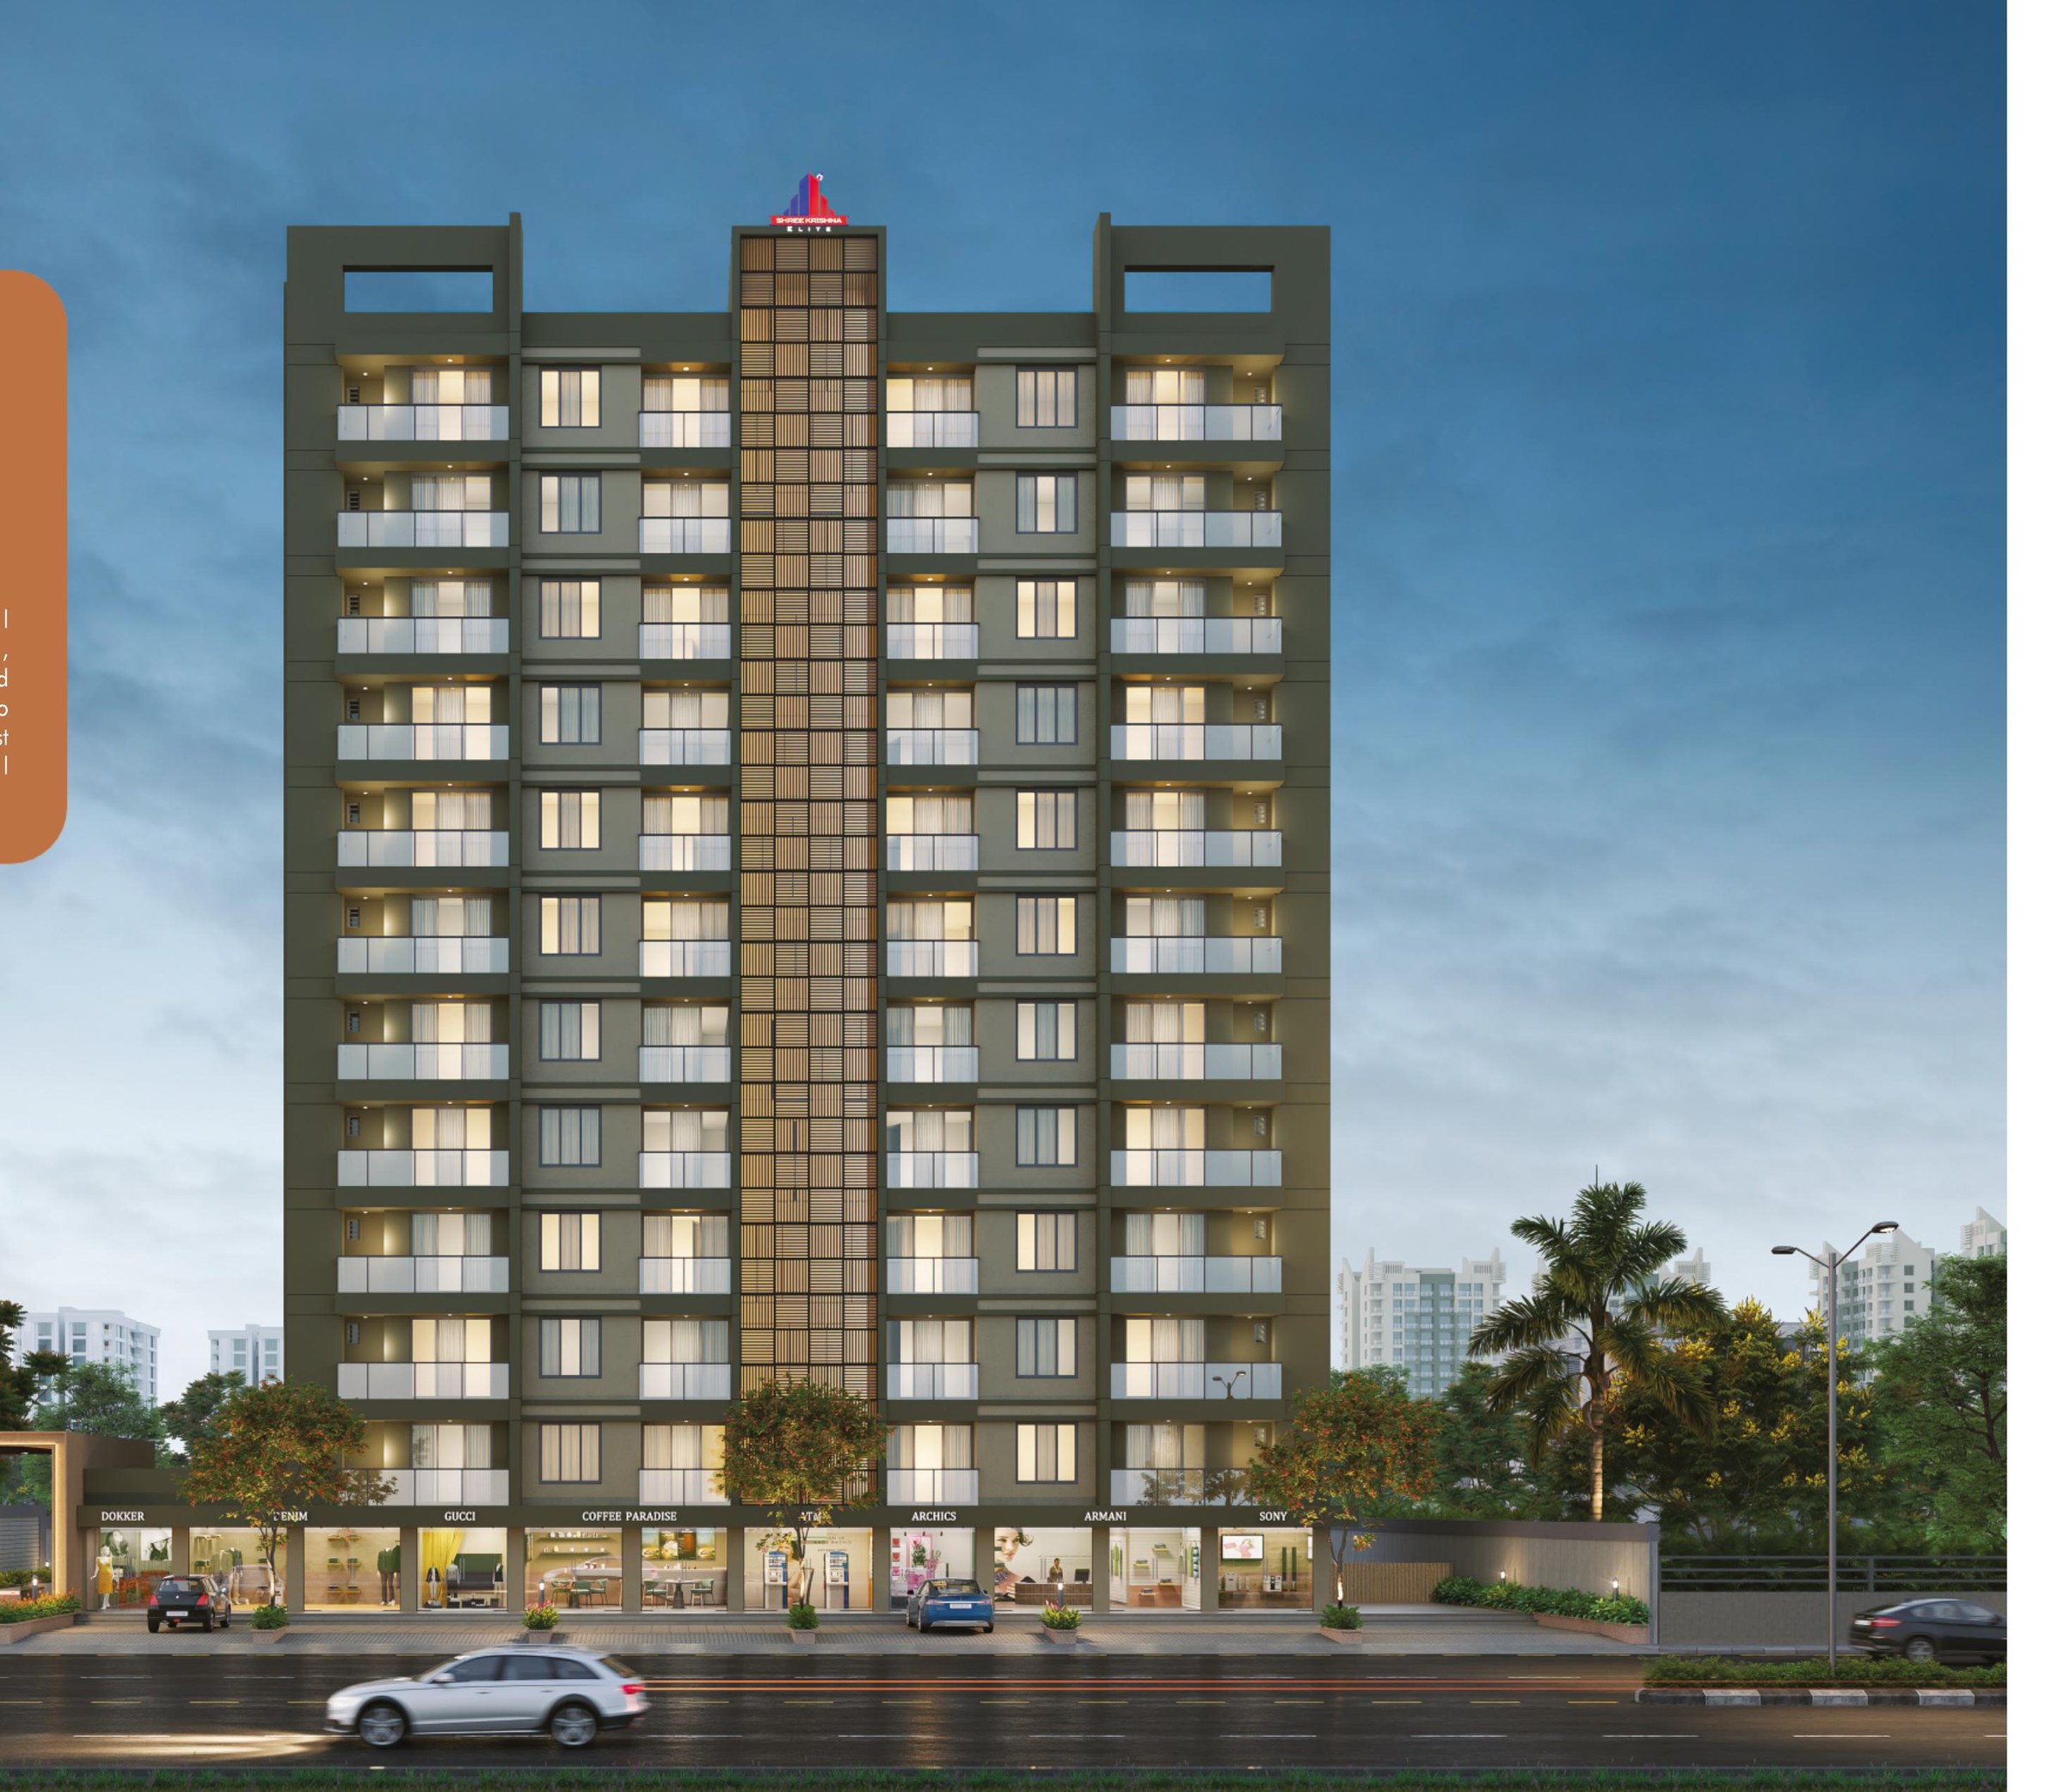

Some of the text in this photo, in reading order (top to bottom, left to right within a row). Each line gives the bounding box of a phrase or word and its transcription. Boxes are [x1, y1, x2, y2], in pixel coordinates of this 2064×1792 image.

[101, 1511, 144, 1521] DOKKER
[445, 1511, 476, 1521] GUCCI
[582, 1511, 677, 1521] COFFEE PARADISE
[912, 1511, 956, 1521] ARCHICS
[1084, 1511, 1127, 1521] ARMANI
[1259, 1511, 1287, 1521] SONY
